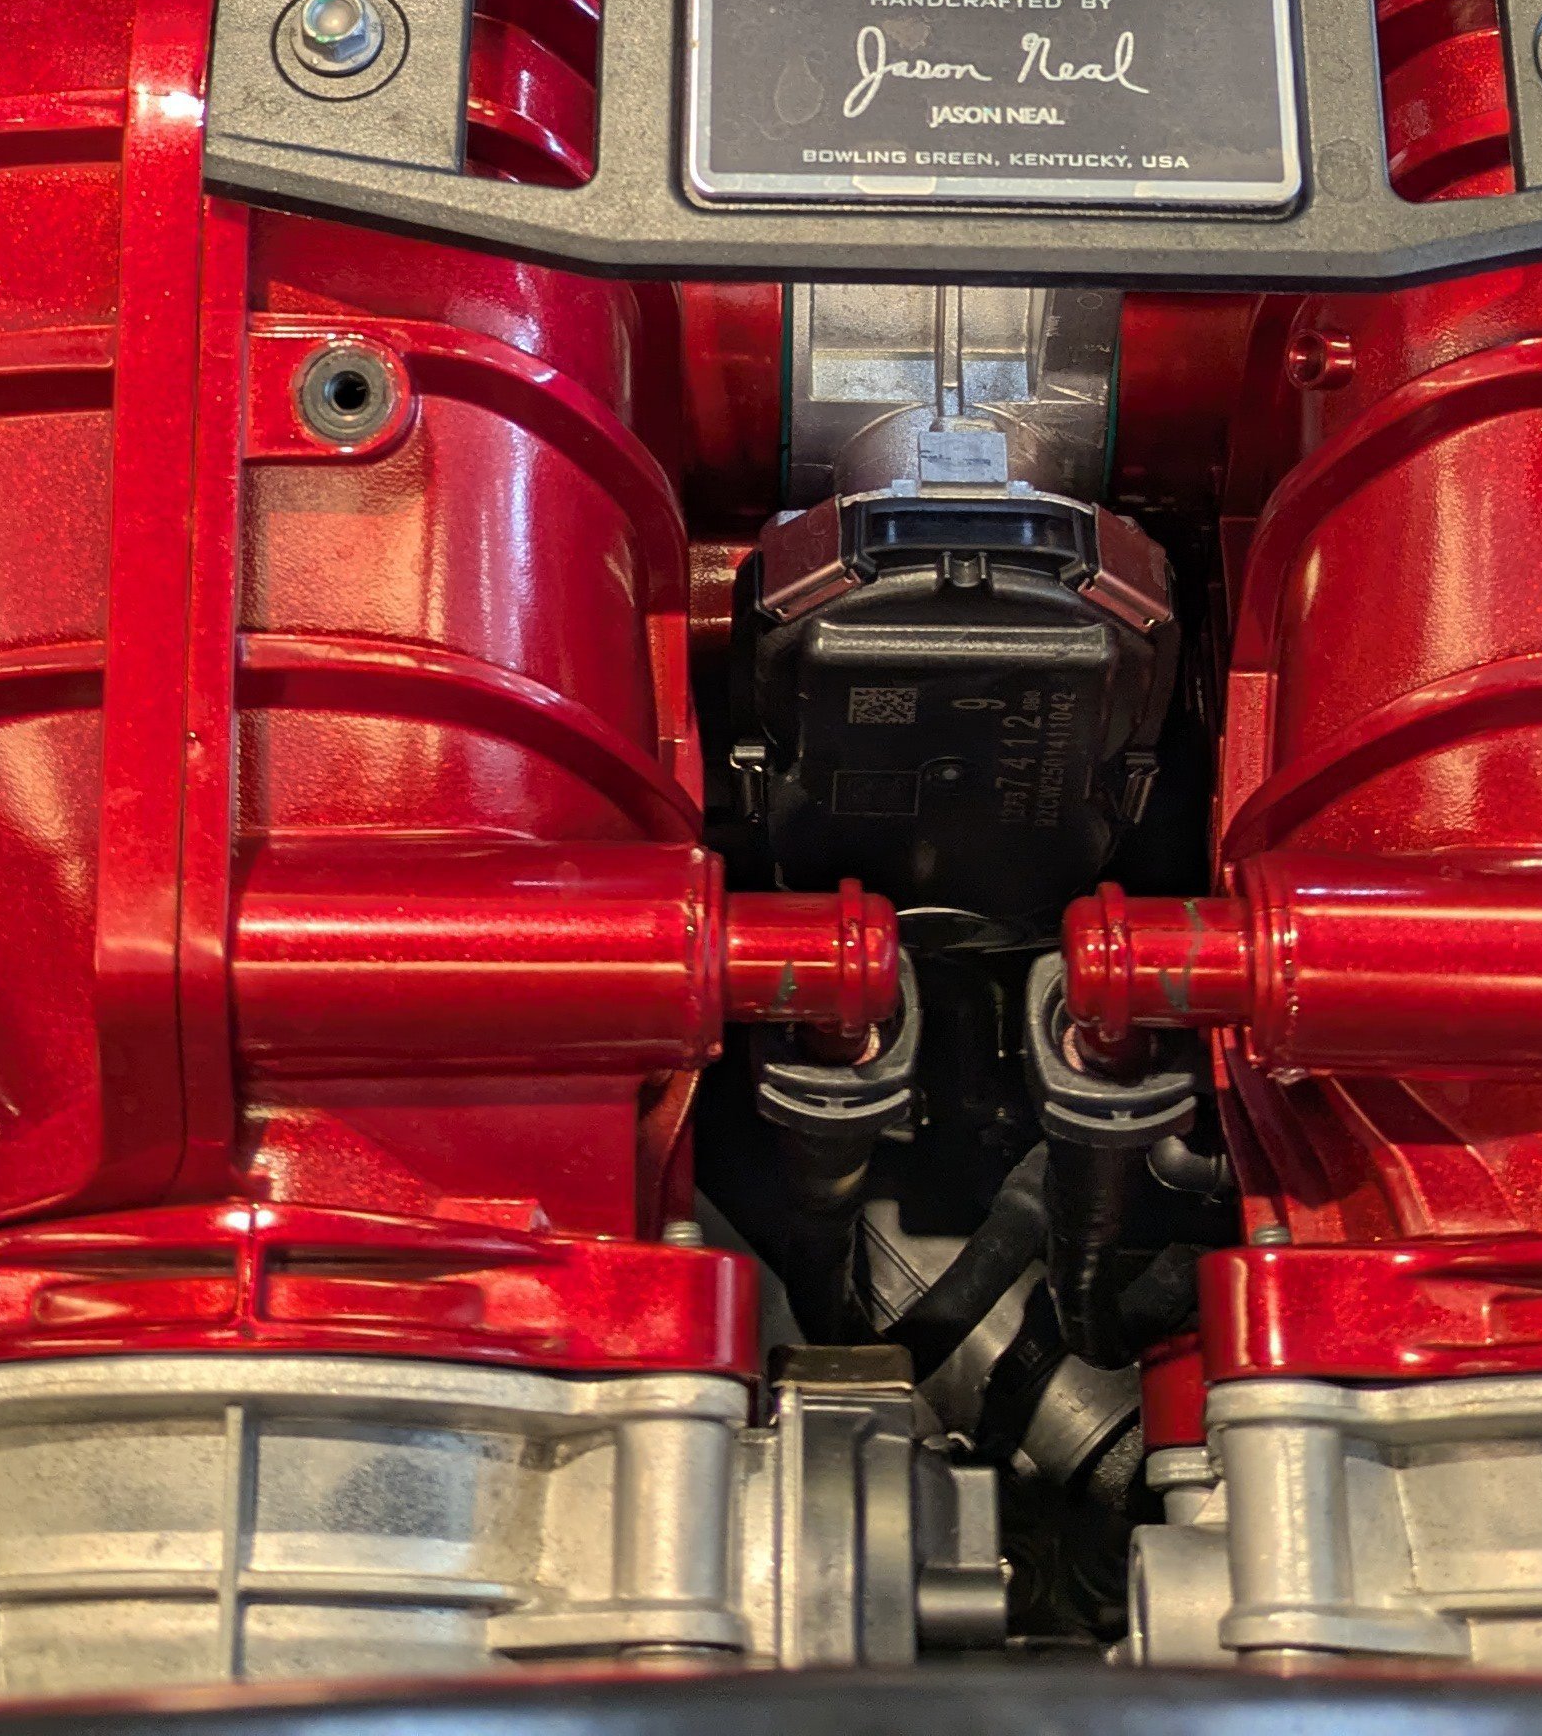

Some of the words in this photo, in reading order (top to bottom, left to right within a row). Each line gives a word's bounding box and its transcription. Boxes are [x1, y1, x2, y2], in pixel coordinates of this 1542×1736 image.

[842, 25, 993, 119] Jason
[1016, 31, 1151, 94] Neal
[929, 104, 1004, 127] JASON
[1005, 106, 1066, 126] NEAL
[801, 148, 907, 166] BOWLING
[914, 150, 1001, 168] GREEN,
[1008, 151, 1133, 170] KENTUCKY,
[1141, 154, 1190, 170] USA
